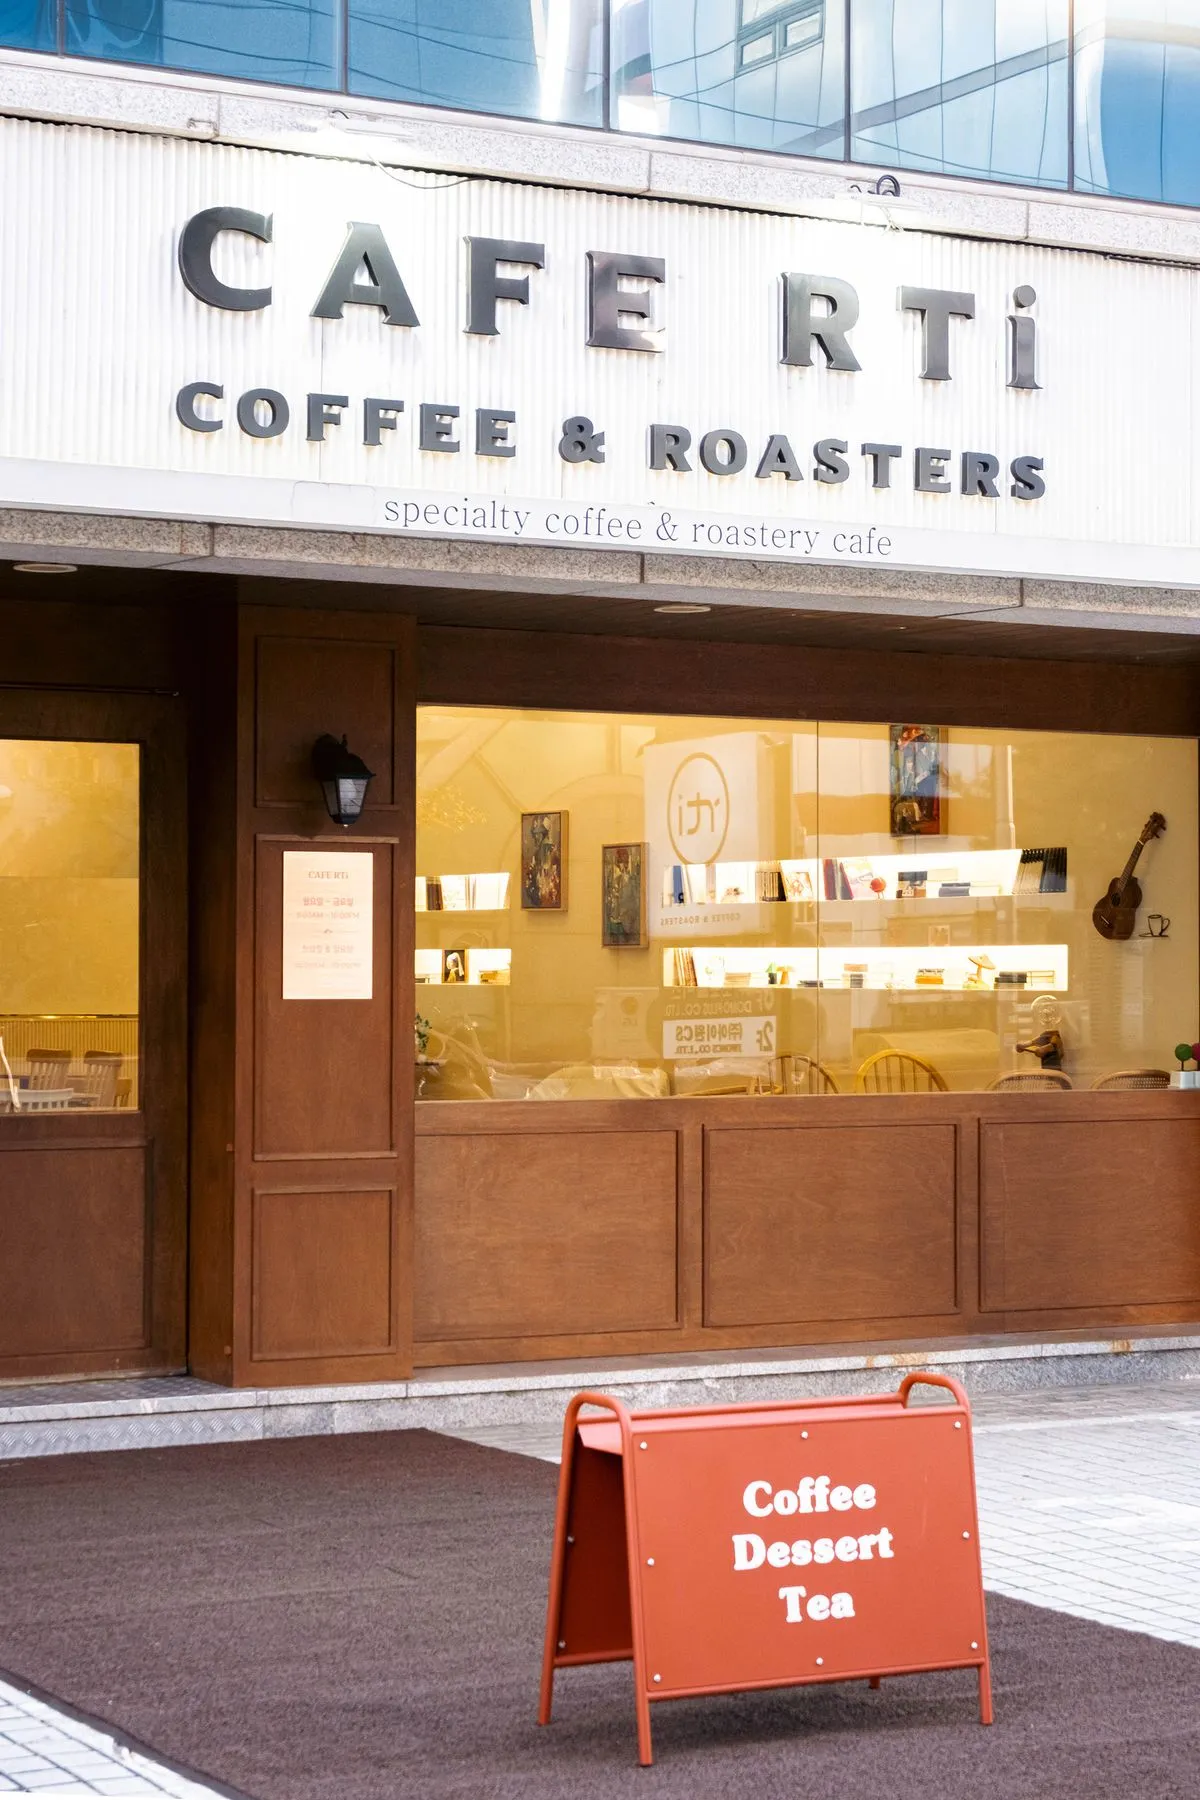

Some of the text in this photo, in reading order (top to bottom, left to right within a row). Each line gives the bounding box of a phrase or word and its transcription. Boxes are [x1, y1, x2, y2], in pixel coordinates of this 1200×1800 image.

[177, 206, 1042, 391] CAFE RTi
[177, 382, 1046, 501] COFFEE & ROASTERS
[384, 497, 892, 556] specialty coffee & roastery cafe
[308, 871, 331, 880] CAFE
[743, 1475, 877, 1518] Coffee
[731, 1526, 895, 1571] Dessert
[778, 1585, 855, 1623] Tea
